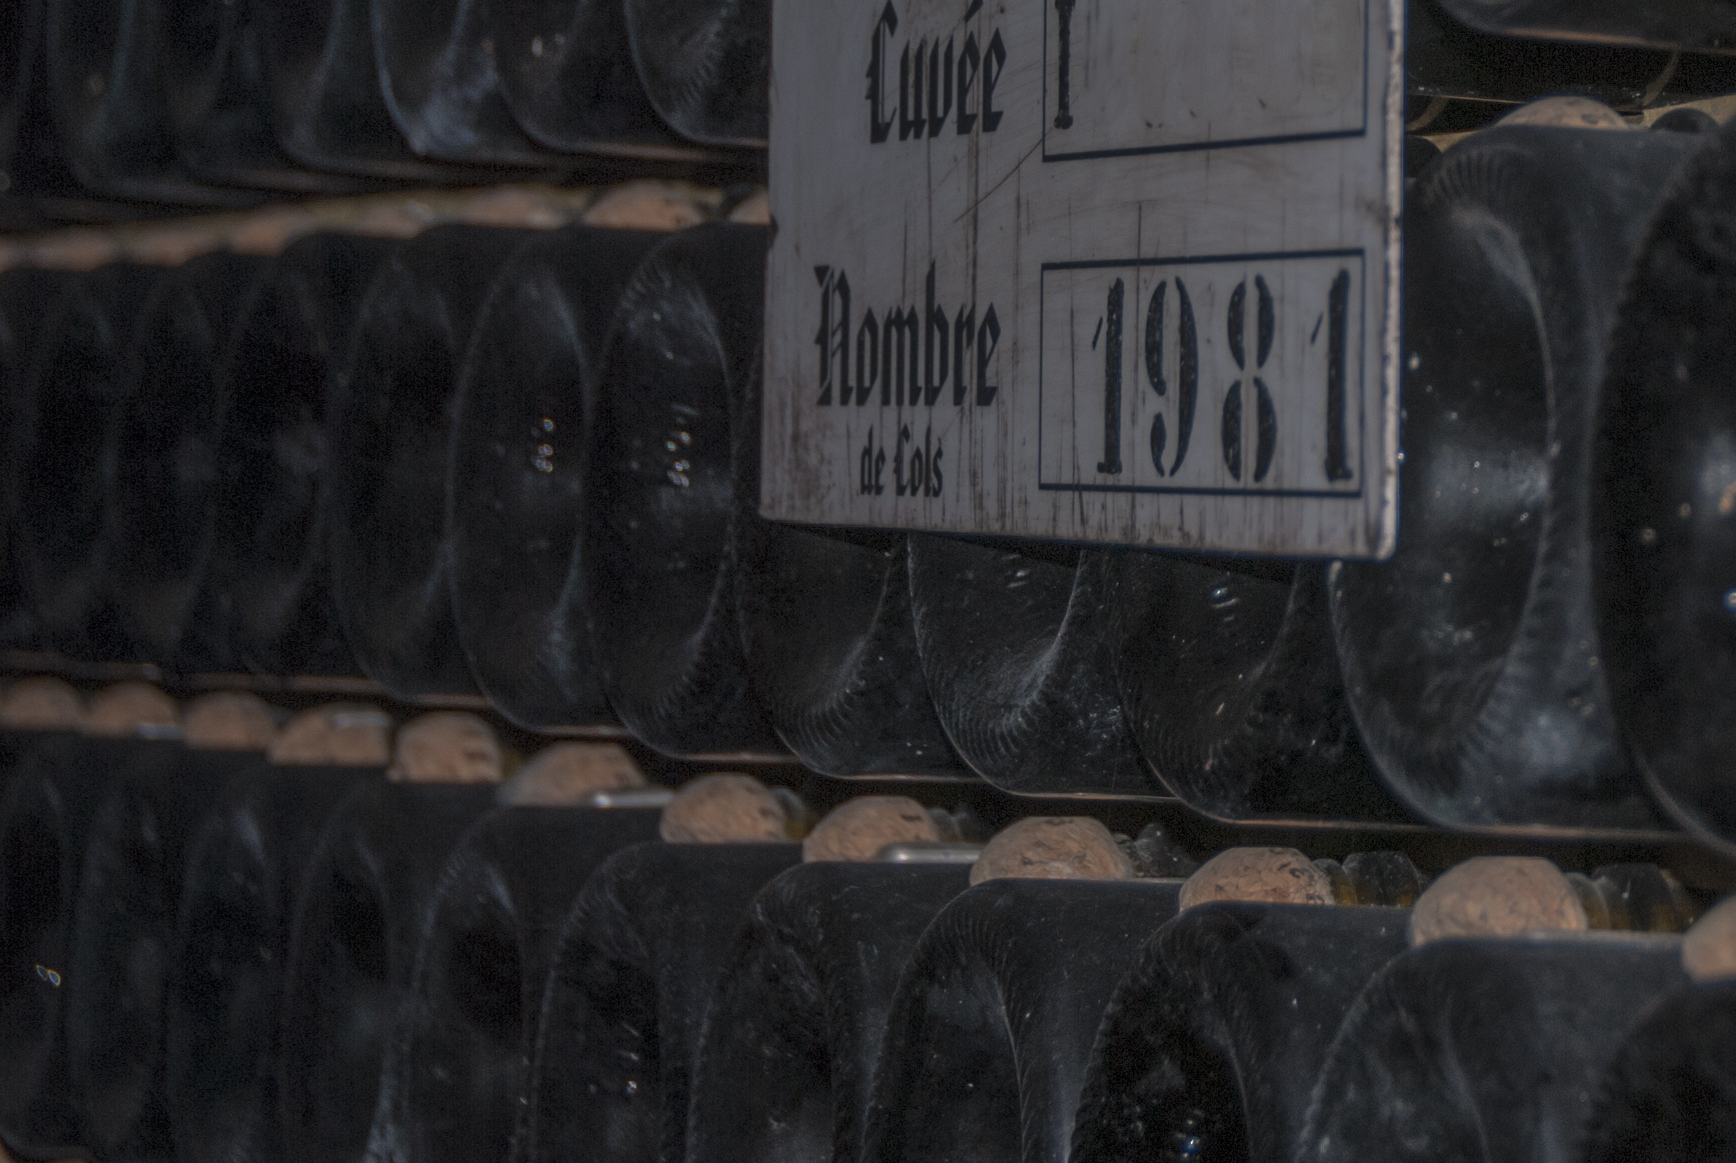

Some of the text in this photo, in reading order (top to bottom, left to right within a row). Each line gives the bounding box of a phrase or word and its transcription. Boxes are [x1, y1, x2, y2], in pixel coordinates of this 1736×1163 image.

[813, 258, 1354, 483] Nombre 1981
[860, 424, 886, 496] de
